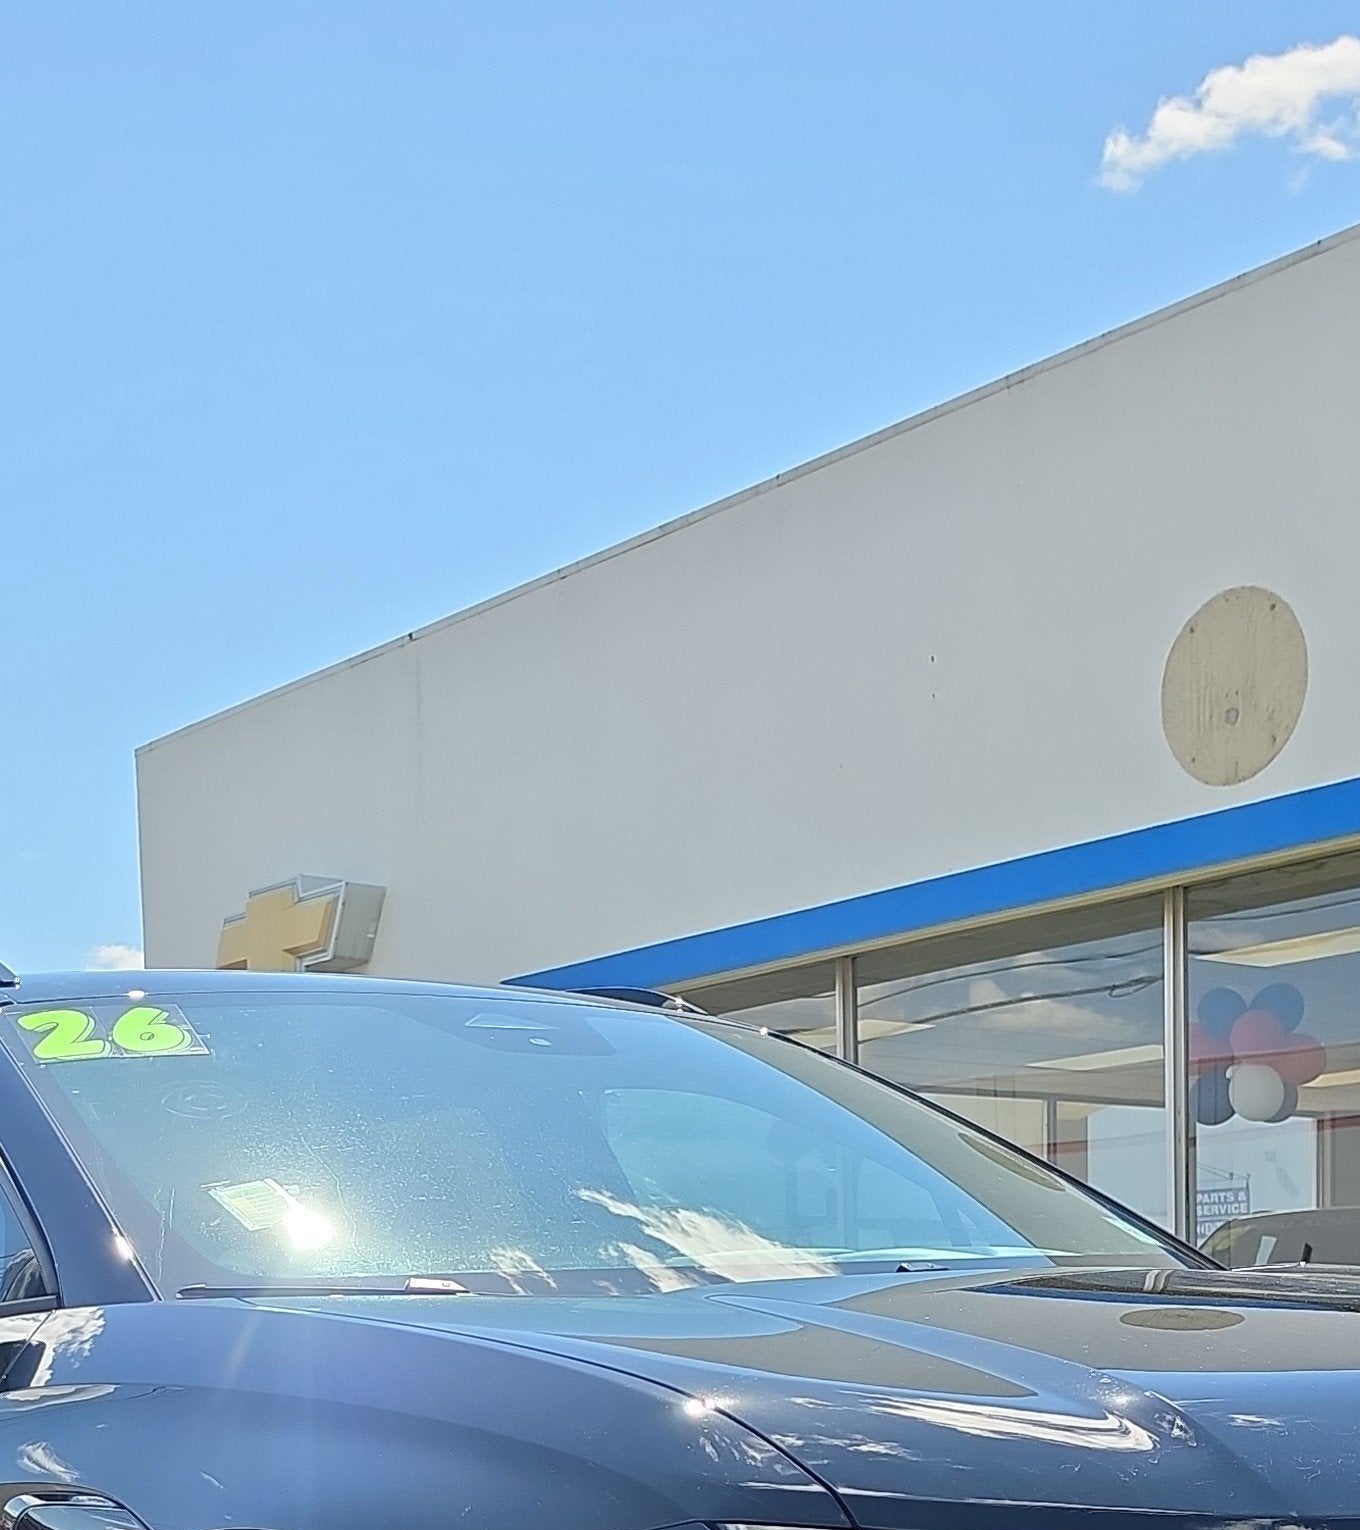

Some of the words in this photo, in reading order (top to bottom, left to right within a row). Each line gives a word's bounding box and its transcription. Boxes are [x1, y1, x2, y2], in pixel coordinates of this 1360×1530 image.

[17, 1007, 192, 1060] 26
[1196, 1191, 1234, 1204] PARTS
[1196, 1203, 1248, 1216] SERVICE
